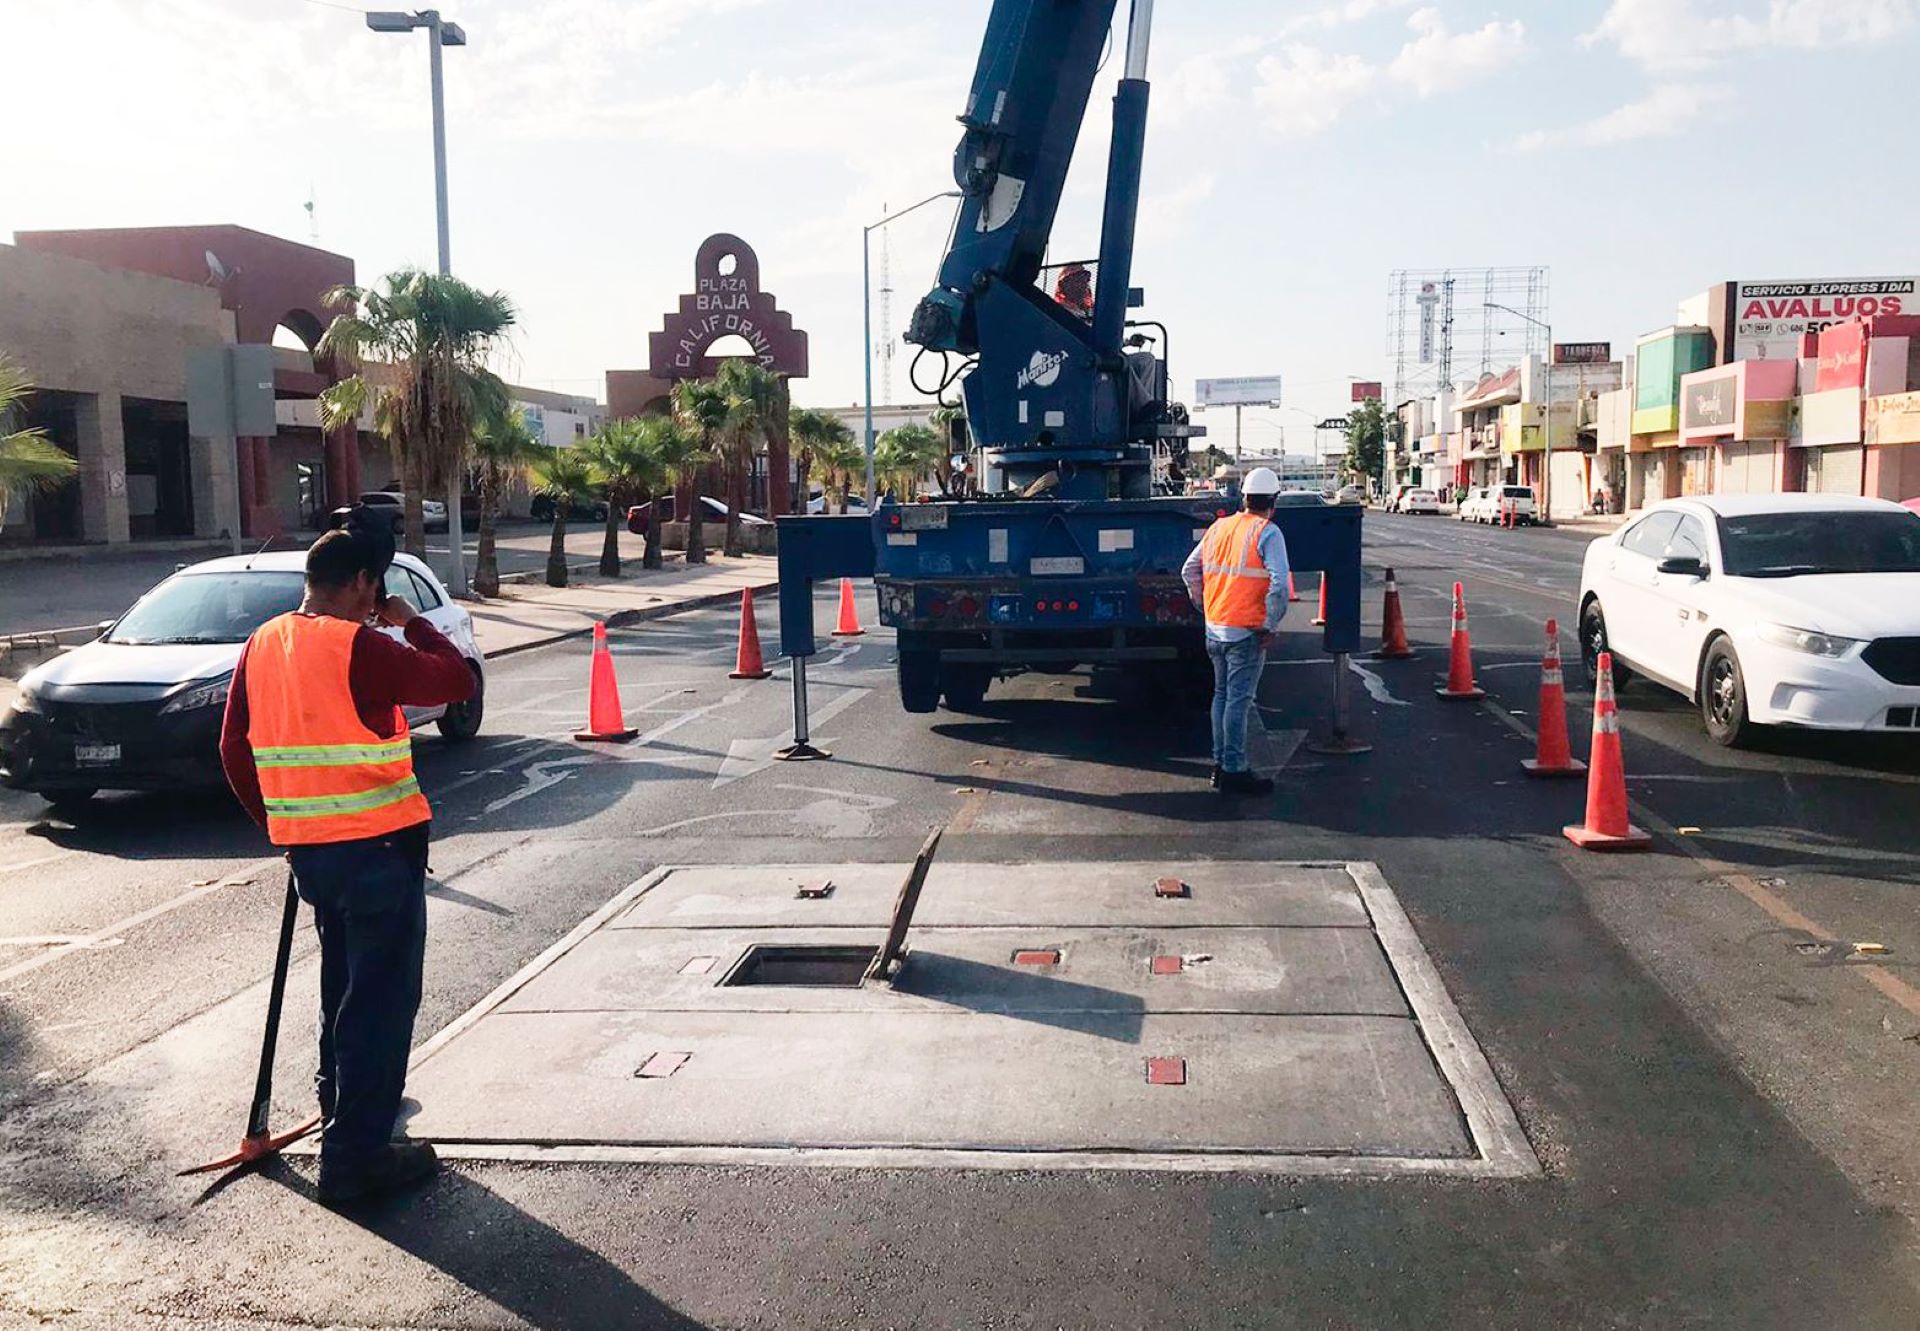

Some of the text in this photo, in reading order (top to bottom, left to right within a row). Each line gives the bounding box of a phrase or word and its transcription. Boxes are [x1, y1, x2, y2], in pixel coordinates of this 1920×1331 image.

[700, 278, 748, 292] PLAZA
[1743, 285, 1806, 297] SERVICIO
[1809, 282, 1879, 295] EXPRESS
[696, 294, 750, 310] BAJA
[1742, 294, 1902, 319] AVALÚOS
[675, 313, 775, 368] CALIFORNIA
